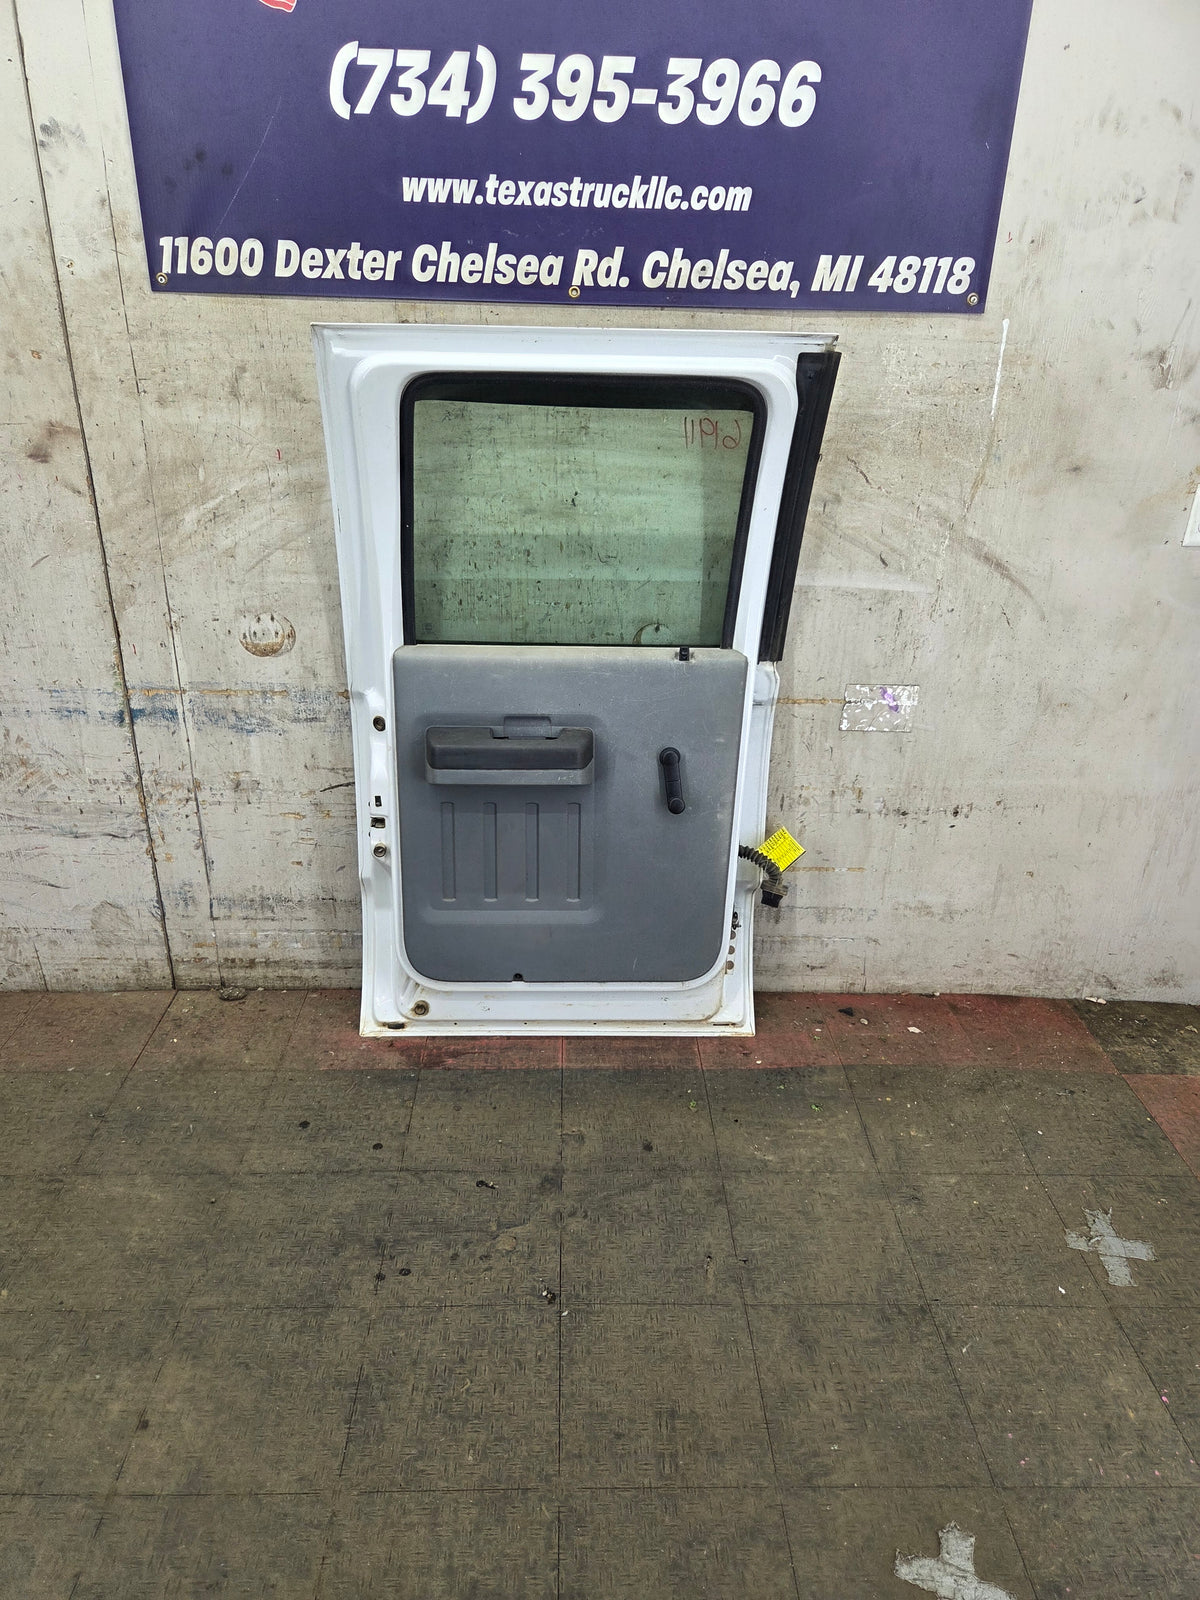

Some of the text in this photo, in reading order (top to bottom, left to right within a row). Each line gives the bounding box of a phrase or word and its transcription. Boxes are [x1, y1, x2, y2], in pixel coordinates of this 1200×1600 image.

[329, 40, 822, 128] (734) 395-3966
[402, 173, 753, 212] www.texastruckllc.com
[157, 236, 976, 298] 11600 Dexter Chelsea Rd. Chelsea, MI 48118
